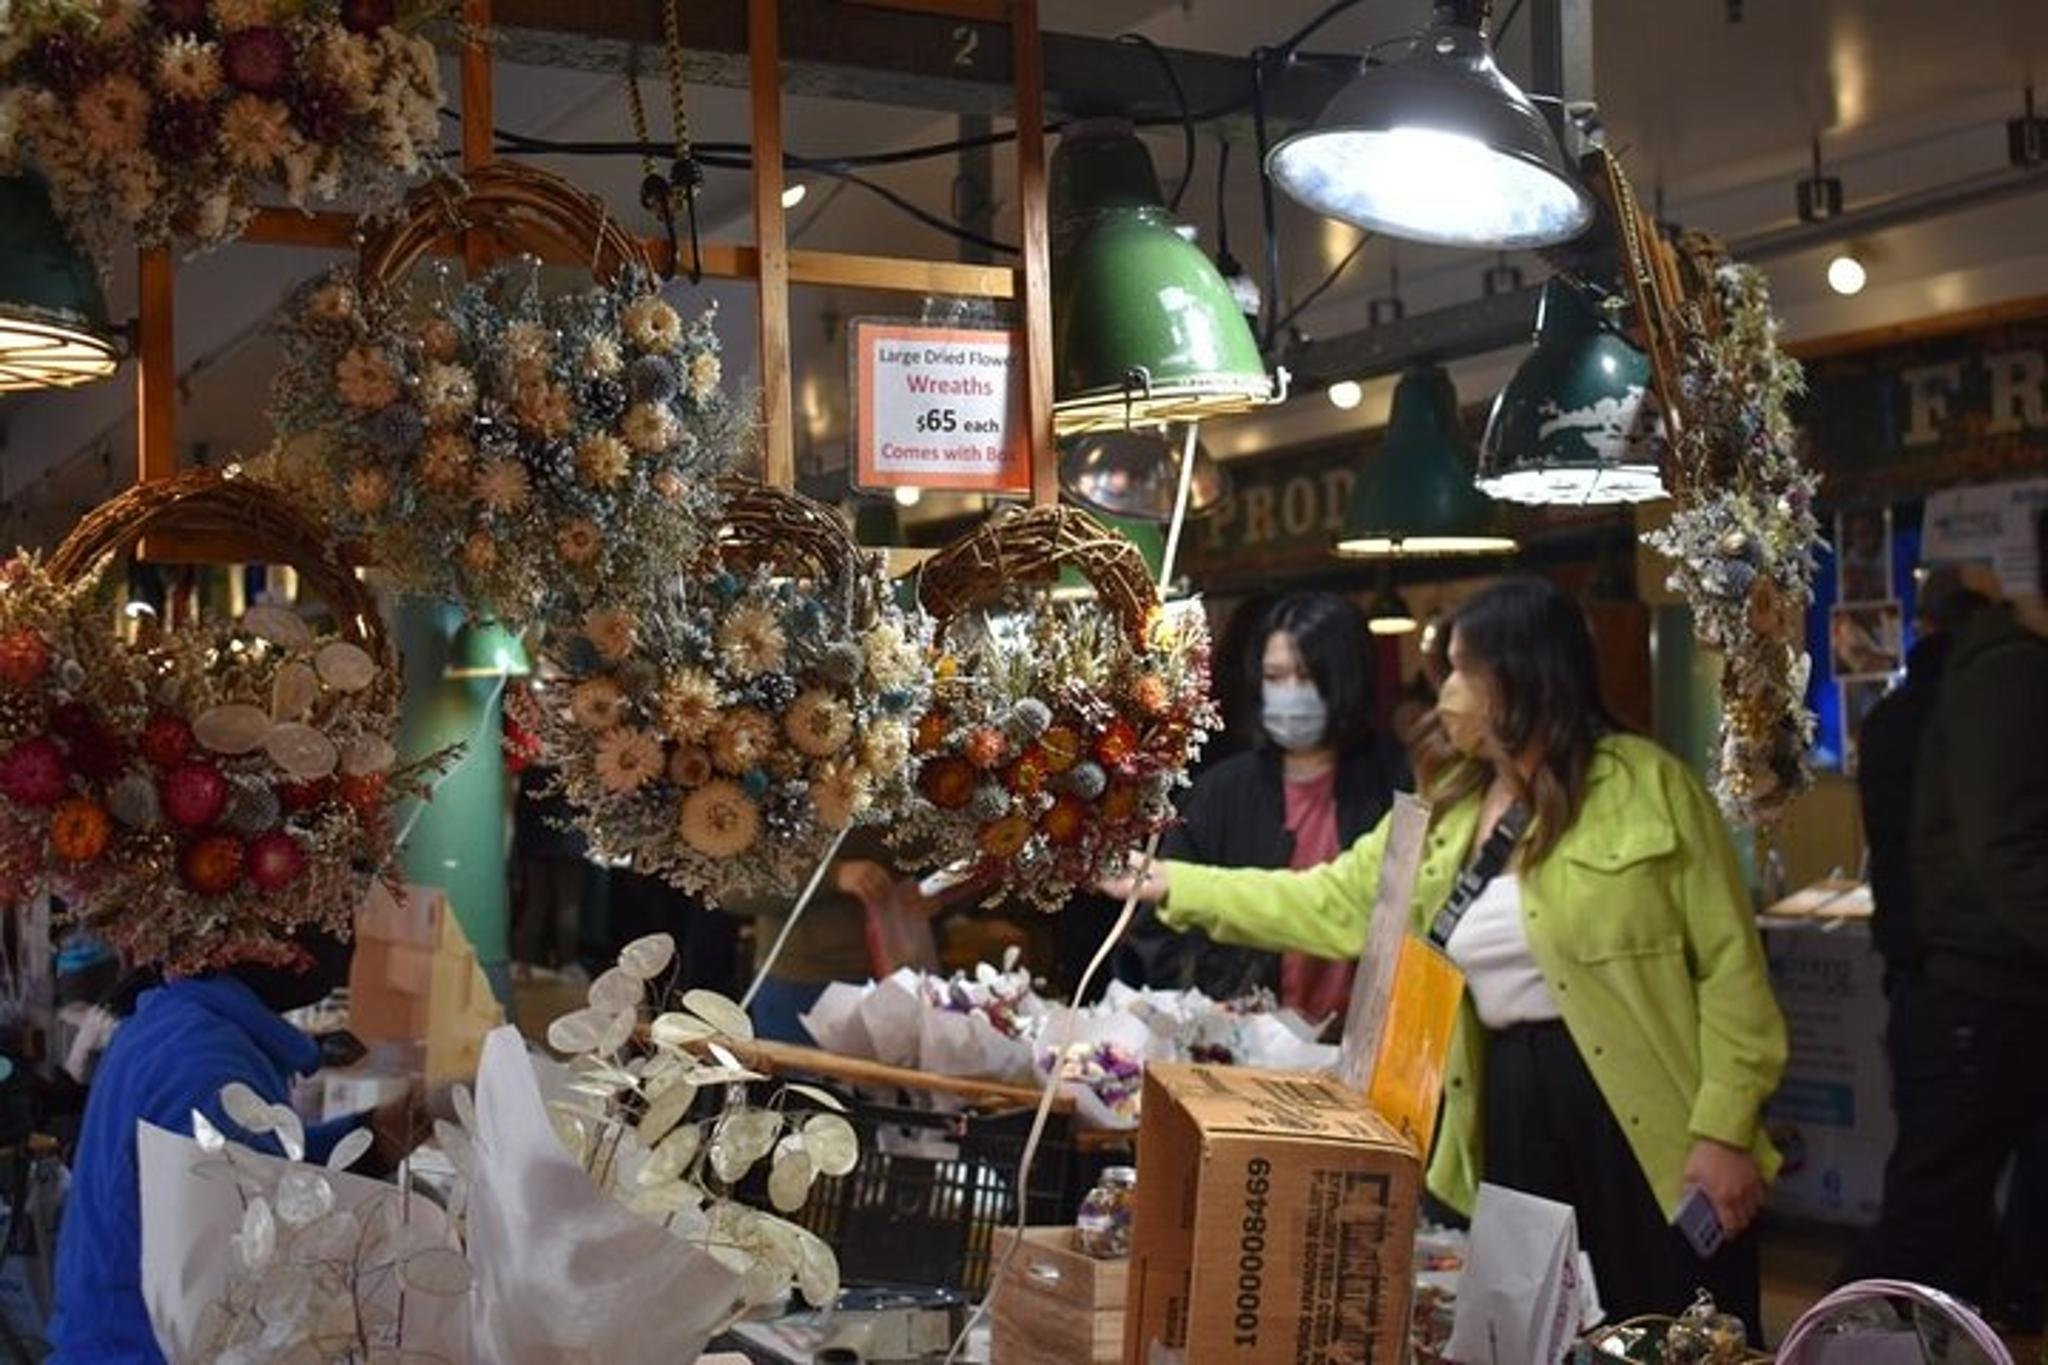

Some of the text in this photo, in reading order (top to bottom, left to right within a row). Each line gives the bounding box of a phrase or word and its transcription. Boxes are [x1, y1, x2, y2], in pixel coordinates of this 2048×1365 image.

[952, 25, 978, 65] 2
[879, 347, 920, 367] Large
[924, 348, 965, 365] Dried
[906, 373, 993, 396] Wreaths
[916, 408, 999, 433] $65 each
[881, 442, 939, 460] Comes
[944, 444, 981, 461] with
[1234, 1157, 1271, 1348] 1000008469
